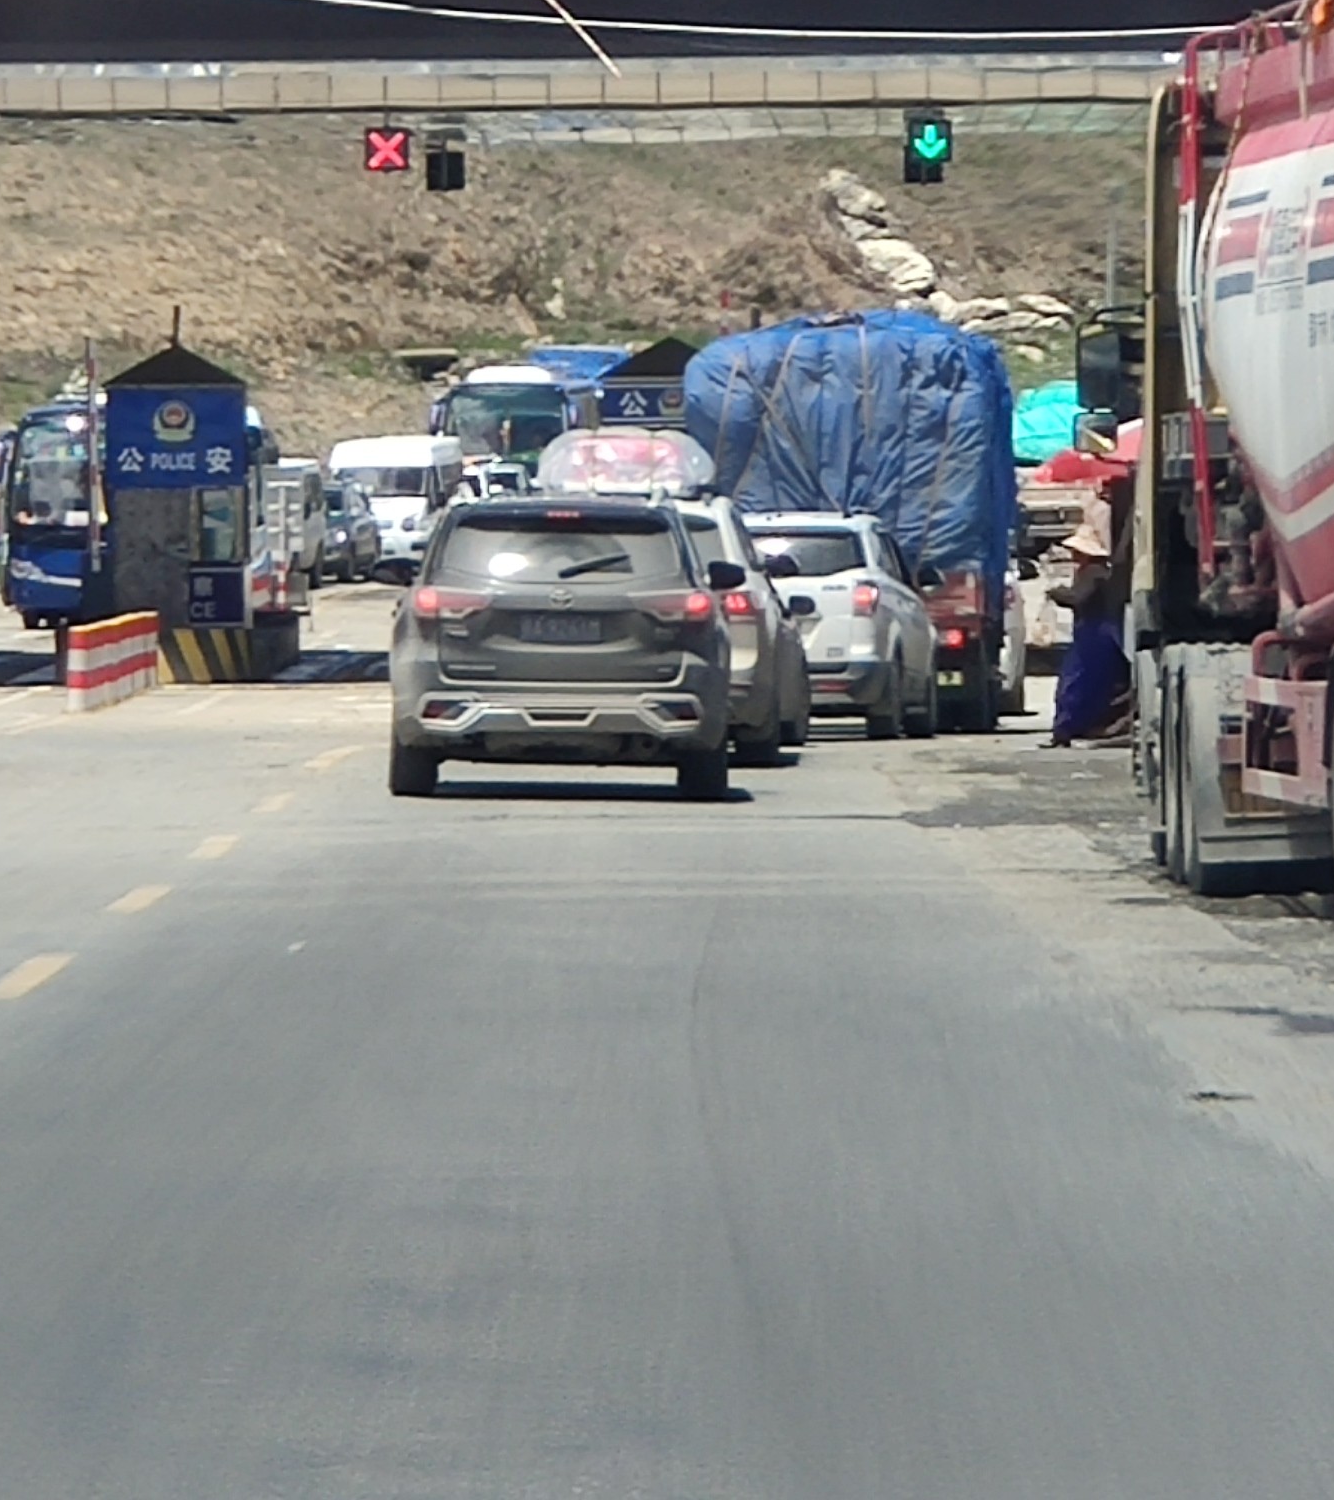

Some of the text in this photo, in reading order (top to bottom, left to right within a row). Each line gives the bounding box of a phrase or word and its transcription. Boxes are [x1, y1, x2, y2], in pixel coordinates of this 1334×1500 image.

[619, 390, 648, 416] 公
[117, 446, 233, 473] 公 POLICE 安
